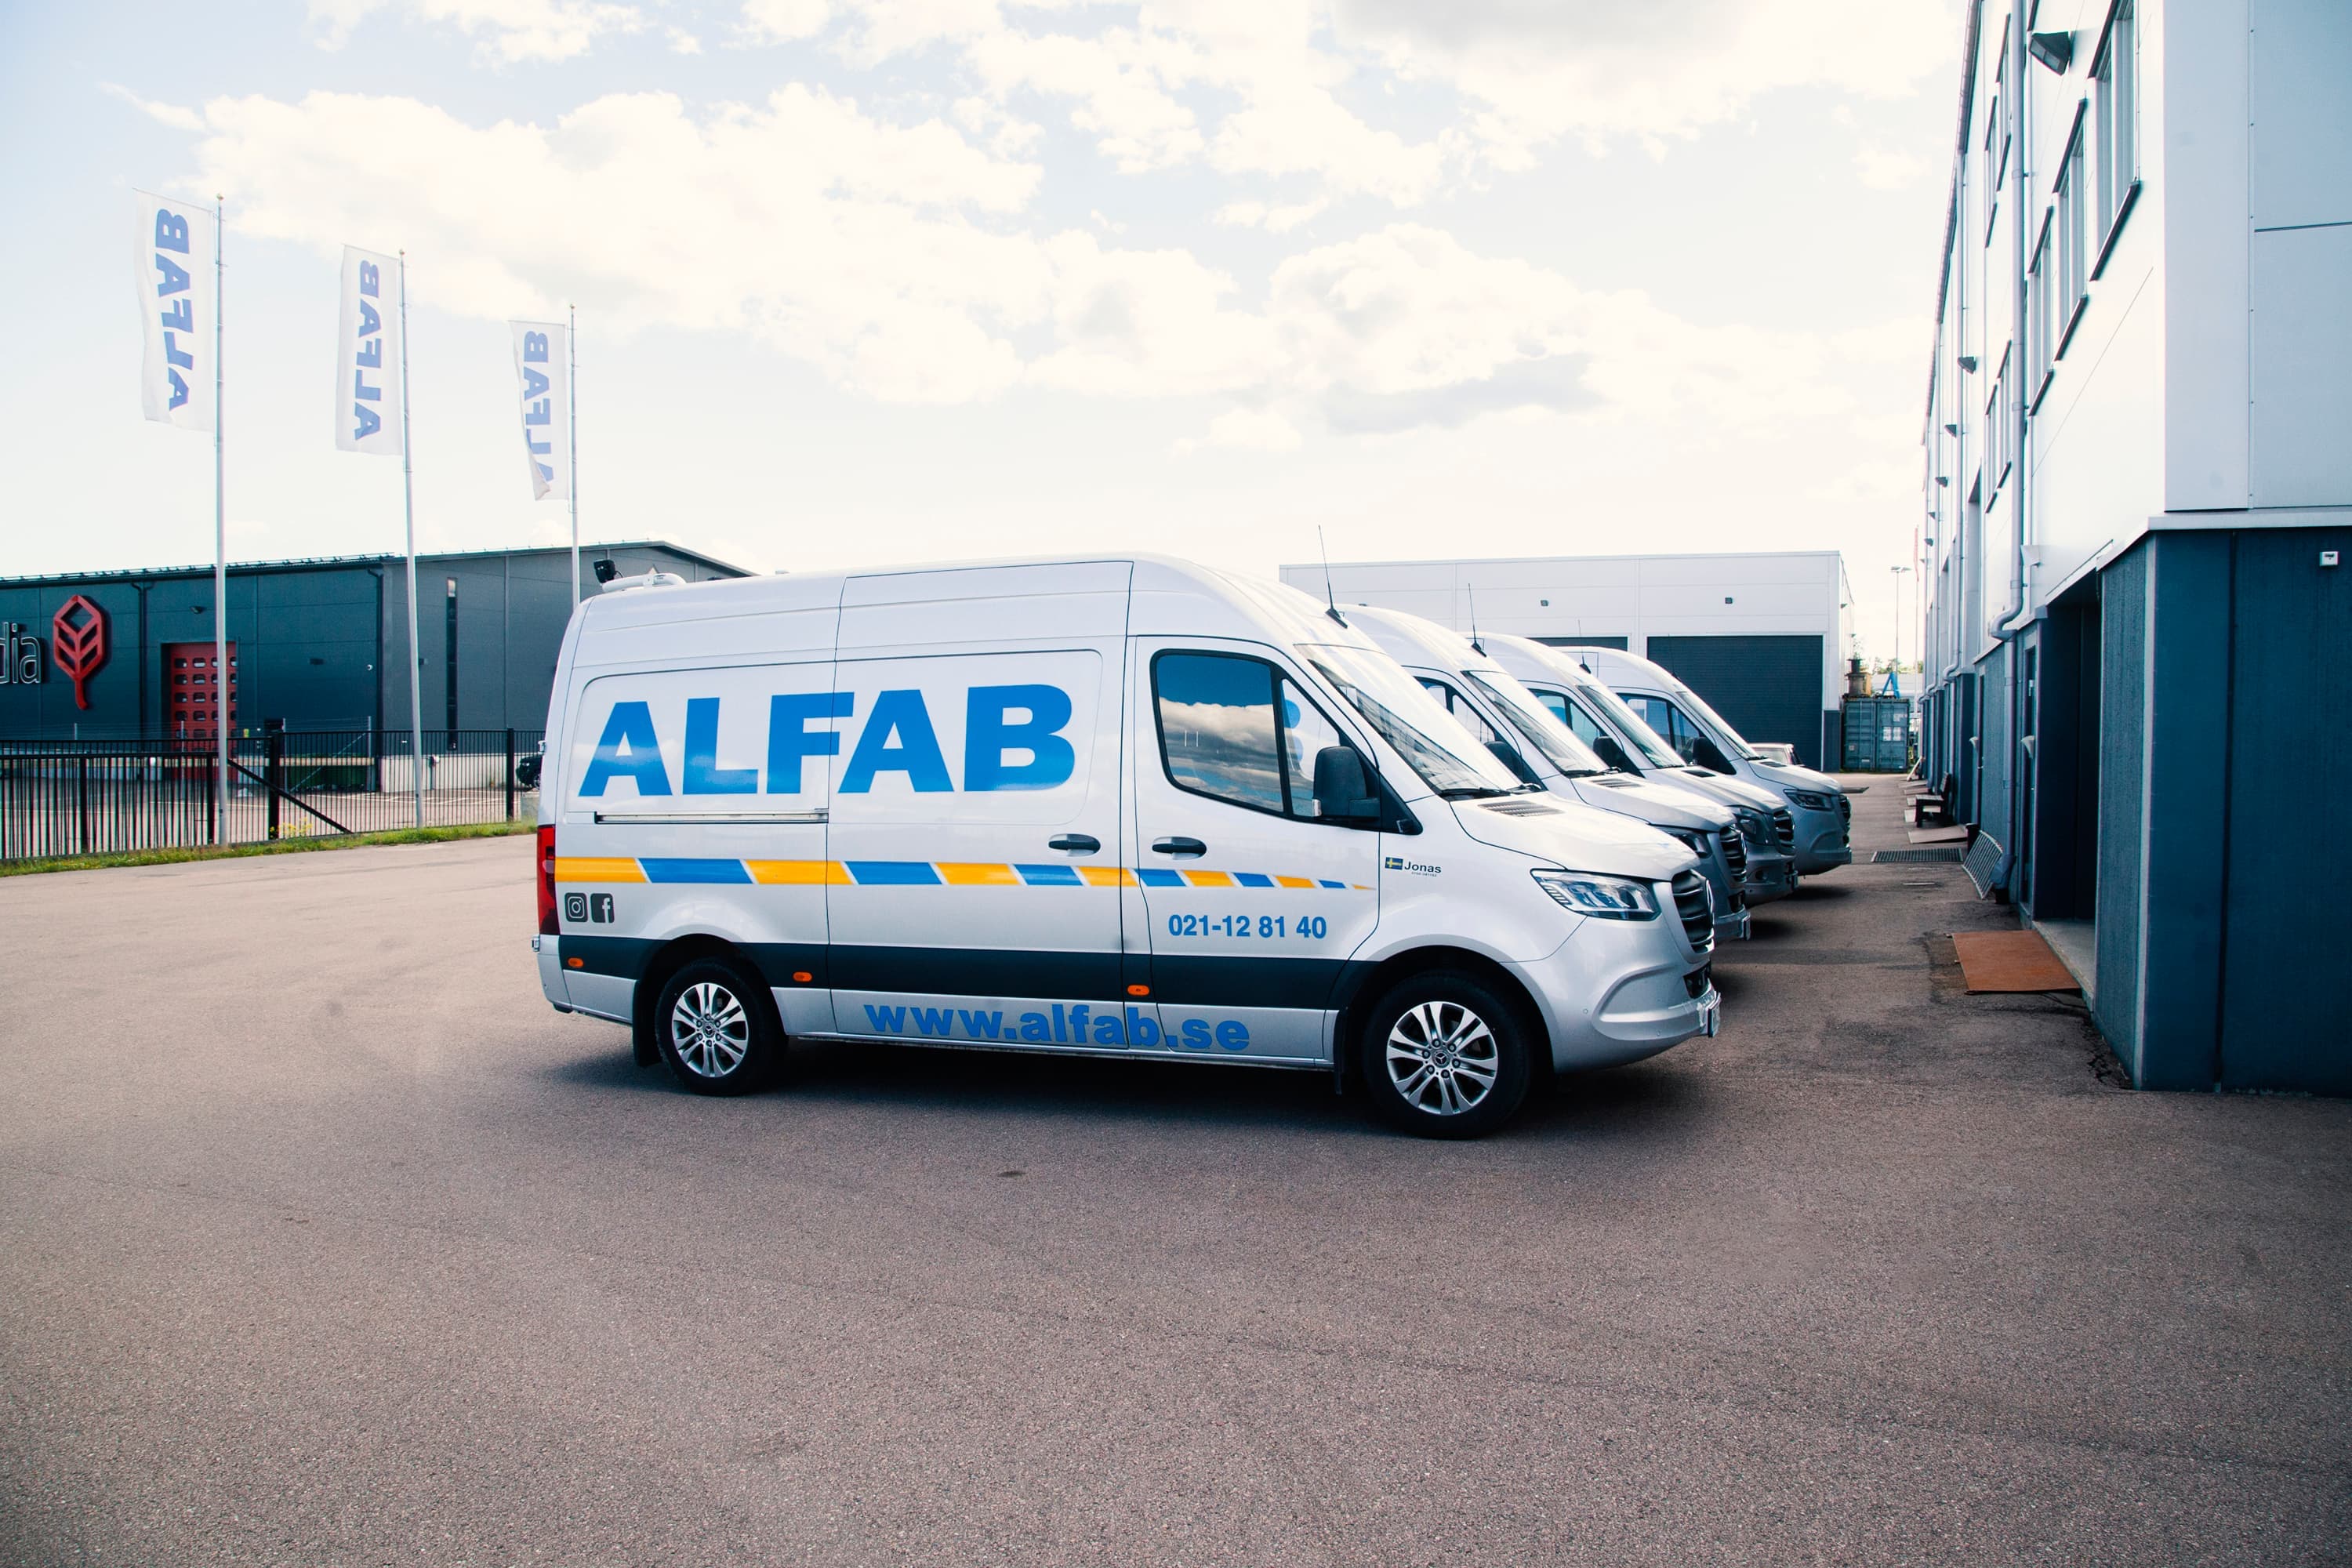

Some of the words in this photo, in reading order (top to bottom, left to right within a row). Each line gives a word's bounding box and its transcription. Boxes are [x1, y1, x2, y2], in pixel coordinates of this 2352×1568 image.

[578, 684, 1076, 797] ALFAB
[1404, 861, 1442, 873] Jonas
[1168, 914, 1250, 937] 021-12
[1258, 916, 1285, 938] 81
[1296, 916, 1327, 939] 40
[864, 1004, 1250, 1051] www.alfab.se
